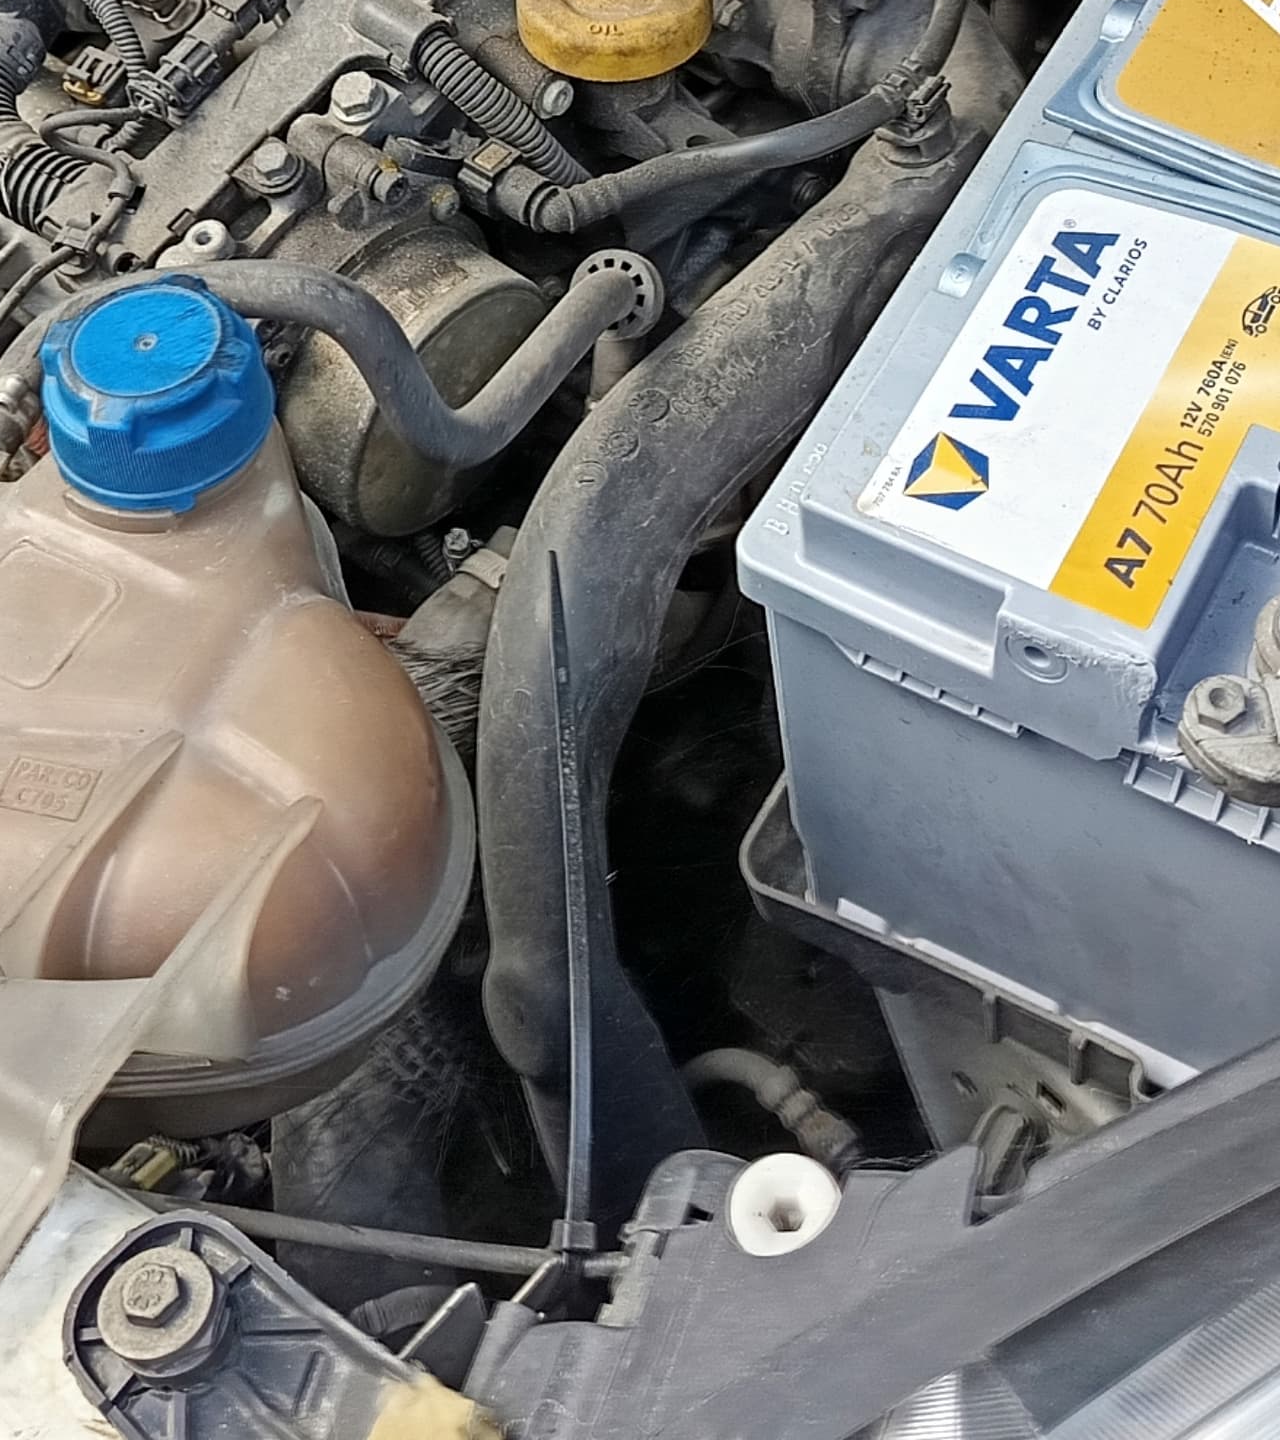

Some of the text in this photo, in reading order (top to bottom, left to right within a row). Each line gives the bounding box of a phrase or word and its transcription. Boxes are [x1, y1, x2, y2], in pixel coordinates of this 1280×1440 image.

[589, 23, 625, 37] OIL
[948, 231, 1121, 421] VARTA
[1087, 237, 1148, 331] BY CLARIOS
[1180, 401, 1204, 430] 12V
[1197, 361, 1247, 438] 570 901 076
[1103, 439, 1205, 589] A7 70Ah
